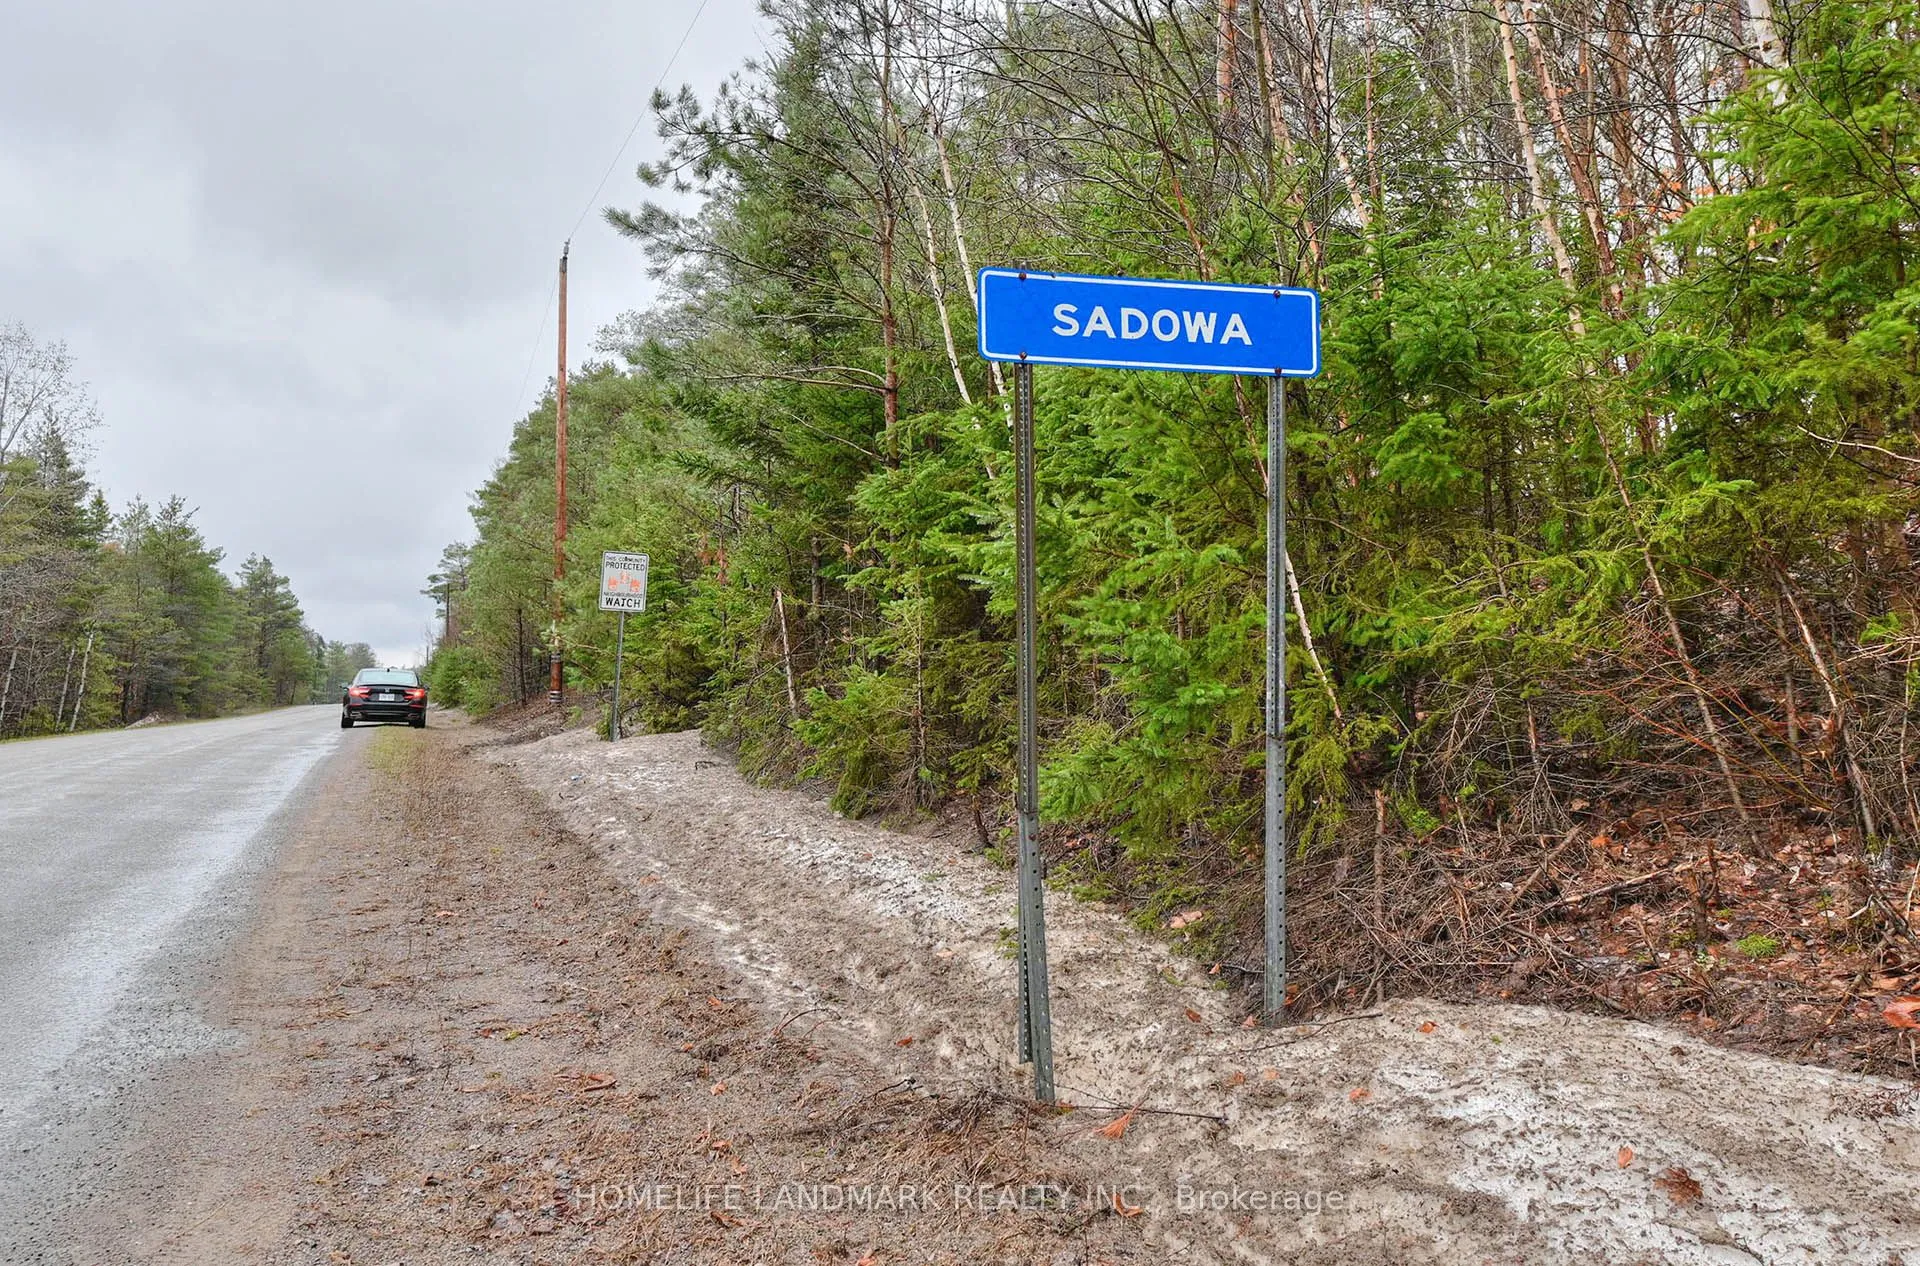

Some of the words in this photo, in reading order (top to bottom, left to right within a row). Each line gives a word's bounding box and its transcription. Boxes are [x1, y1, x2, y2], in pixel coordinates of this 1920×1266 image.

[1052, 303, 1253, 345] SADOWA
[606, 561, 645, 571] PROTECTED
[605, 597, 641, 608] WATCH
